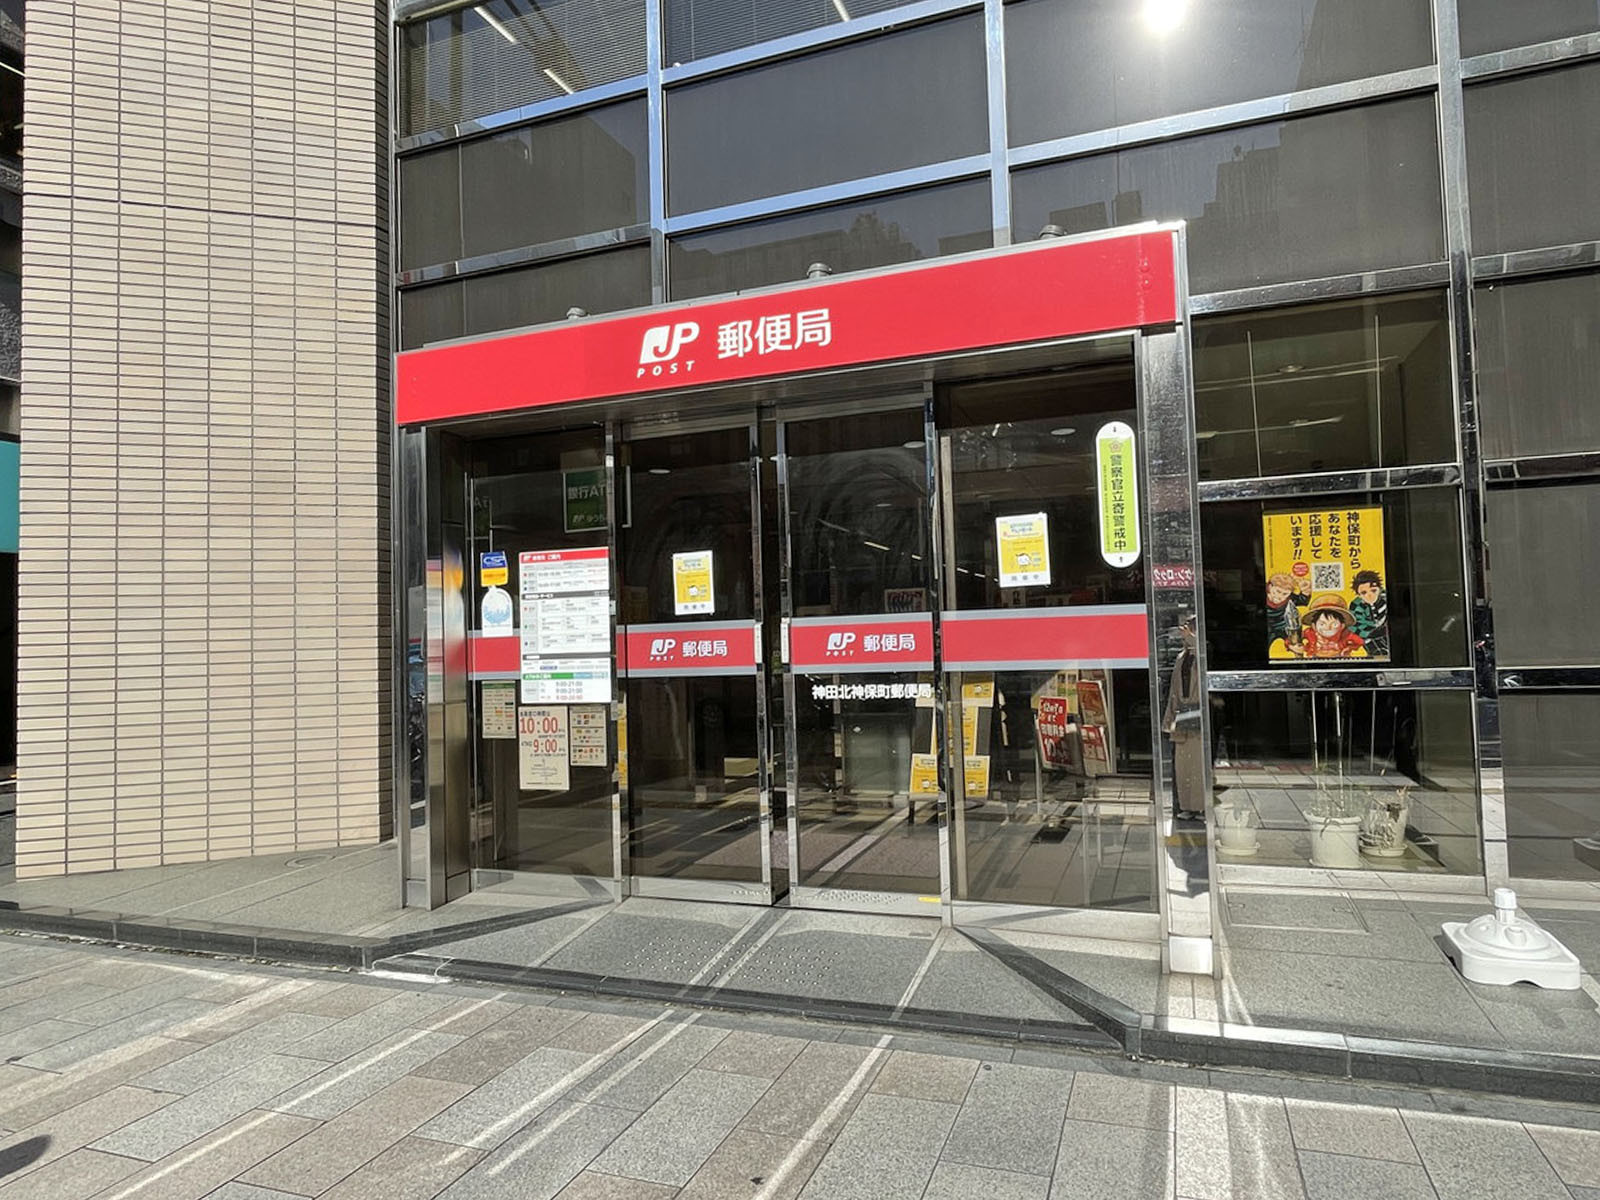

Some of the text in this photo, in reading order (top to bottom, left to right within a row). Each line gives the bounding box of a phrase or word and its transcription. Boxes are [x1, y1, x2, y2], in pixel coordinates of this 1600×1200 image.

[717, 308, 832, 359] 郵便局
[636, 360, 695, 378] POST
[1110, 454, 1127, 551] 警察官立寄警戒中
[1309, 514, 1322, 559] 応援して
[1328, 513, 1342, 559] あなたを
[1347, 511, 1361, 570] 神保町から
[682, 640, 728, 657] 郵便局
[863, 633, 915, 652] 郵便局
[811, 683, 932, 700] 神田北神保町郵便局
[520, 717, 558, 734] 10:00
[533, 739, 557, 753] 9:00
